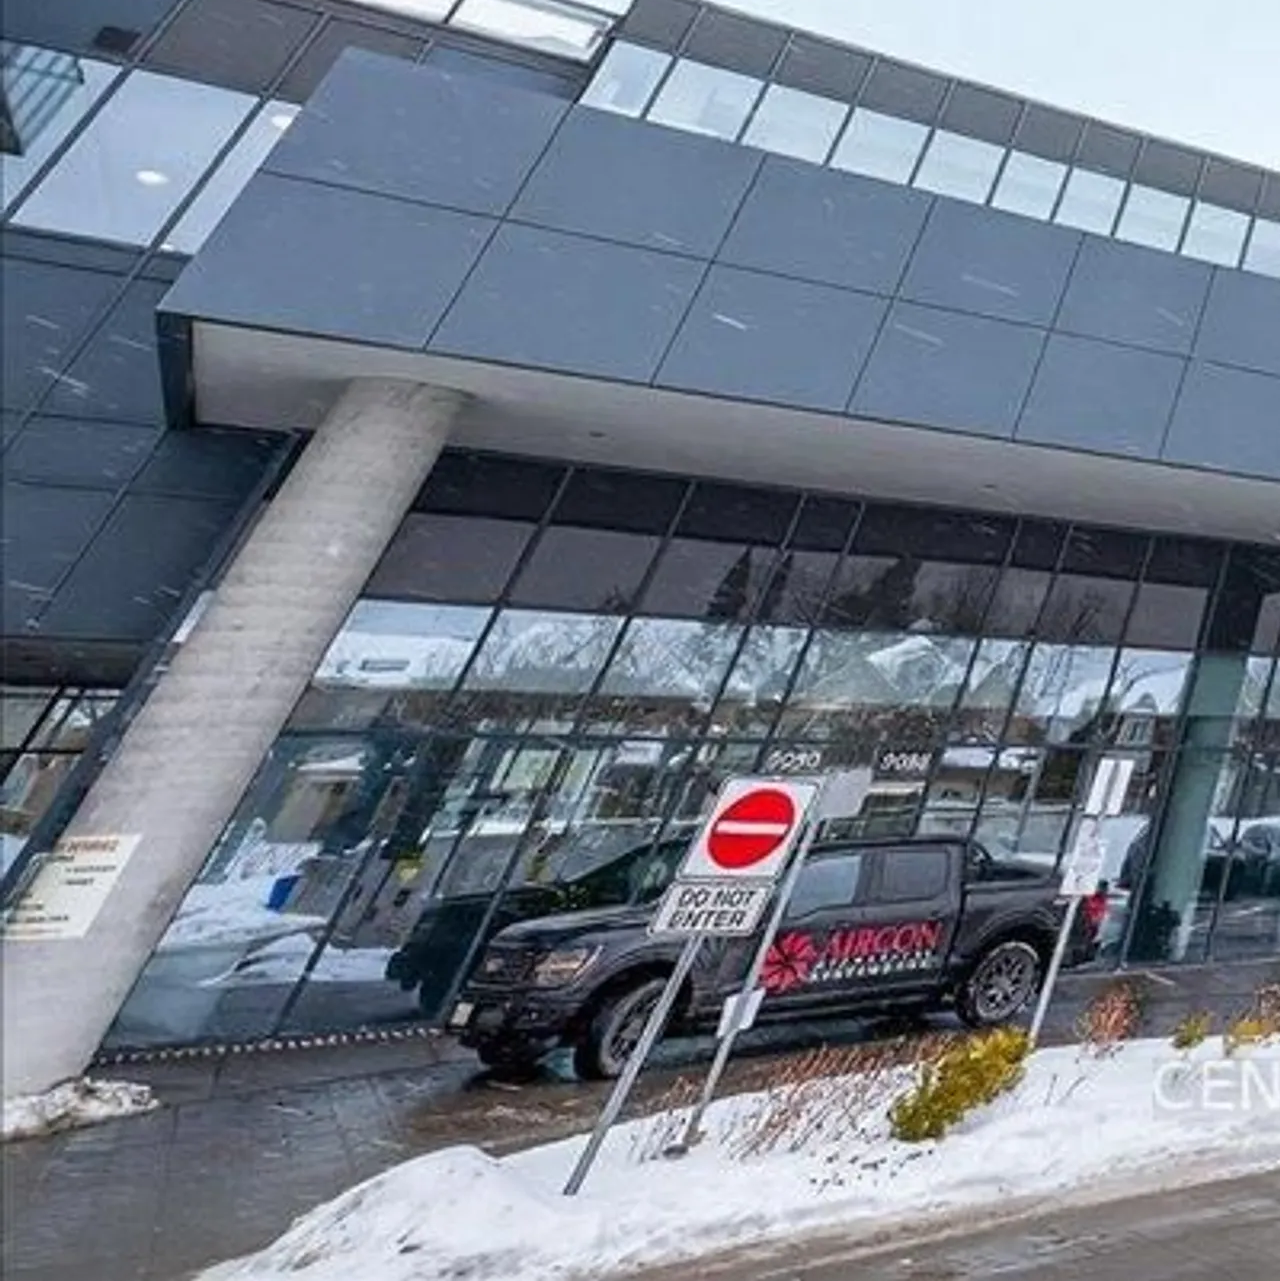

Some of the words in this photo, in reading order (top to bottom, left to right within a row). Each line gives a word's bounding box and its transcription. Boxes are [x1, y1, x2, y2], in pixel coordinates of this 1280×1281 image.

[679, 887, 711, 907] DO
[713, 889, 757, 907] NOT
[668, 910, 747, 928] ENTER
[825, 920, 944, 958] AIRCON
